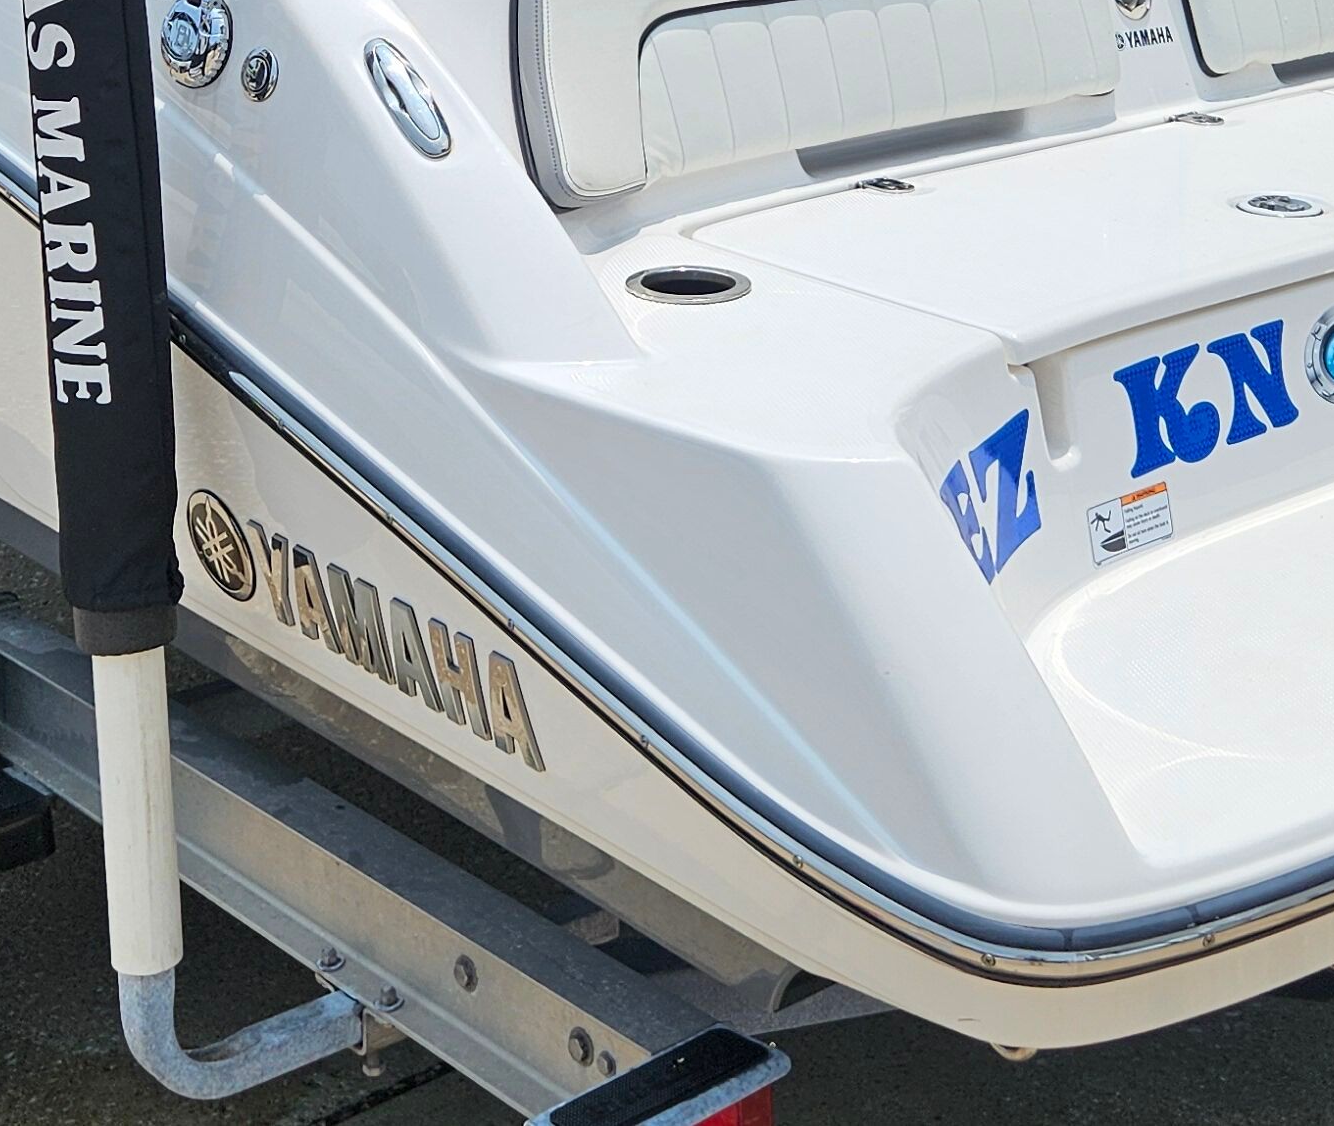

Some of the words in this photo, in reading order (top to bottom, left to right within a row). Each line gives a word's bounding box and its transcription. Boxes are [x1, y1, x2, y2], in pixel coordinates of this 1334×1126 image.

[1125, 26, 1174, 48] YAMAHA
[32, 94, 111, 405] MARINE
[246, 519, 546, 772] YAMAHA
